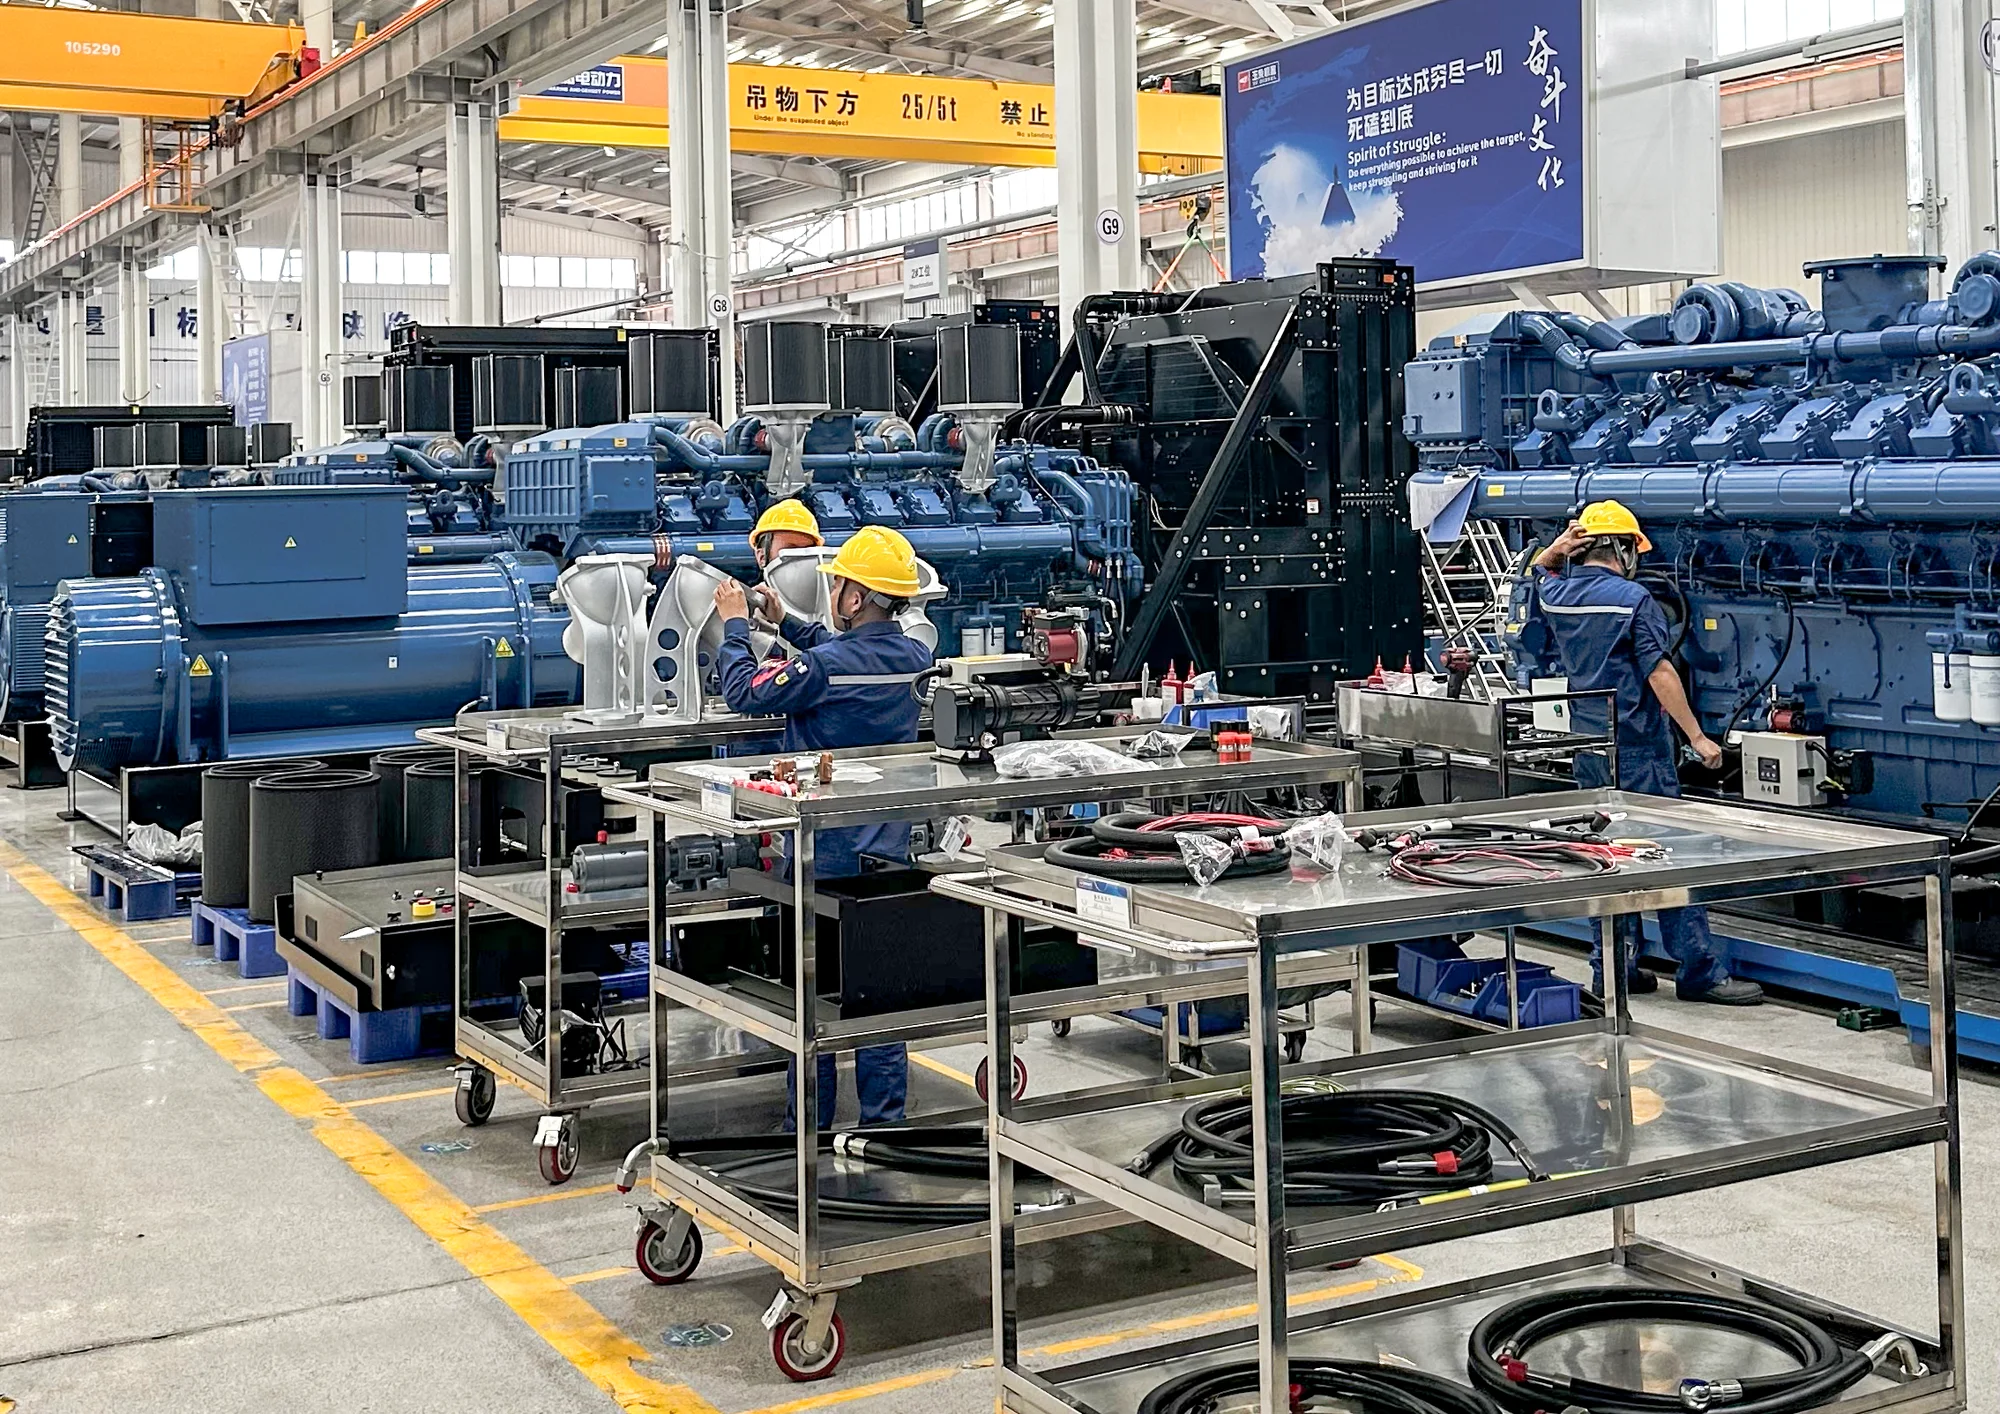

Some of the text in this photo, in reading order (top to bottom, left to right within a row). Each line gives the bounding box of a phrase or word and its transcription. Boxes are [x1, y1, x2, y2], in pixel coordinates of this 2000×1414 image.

[65, 41, 121, 56] 105290
[1347, 49, 1503, 113] 为目标达成穷尽一切
[747, 85, 858, 115] 吊物下方
[902, 93, 957, 121] 25/5t
[1001, 100, 1050, 126] 禁止
[1523, 25, 1567, 191] 奋斗文化
[1348, 104, 1413, 142] 死磕到底
[1348, 132, 1446, 166] Spirit of Struggle:
[1348, 131, 1526, 179] Do everything possible to achieve the target,
[1348, 155, 1478, 192] keep struggling and striving for it
[1102, 217, 1119, 235] G9
[713, 299, 727, 312] G8
